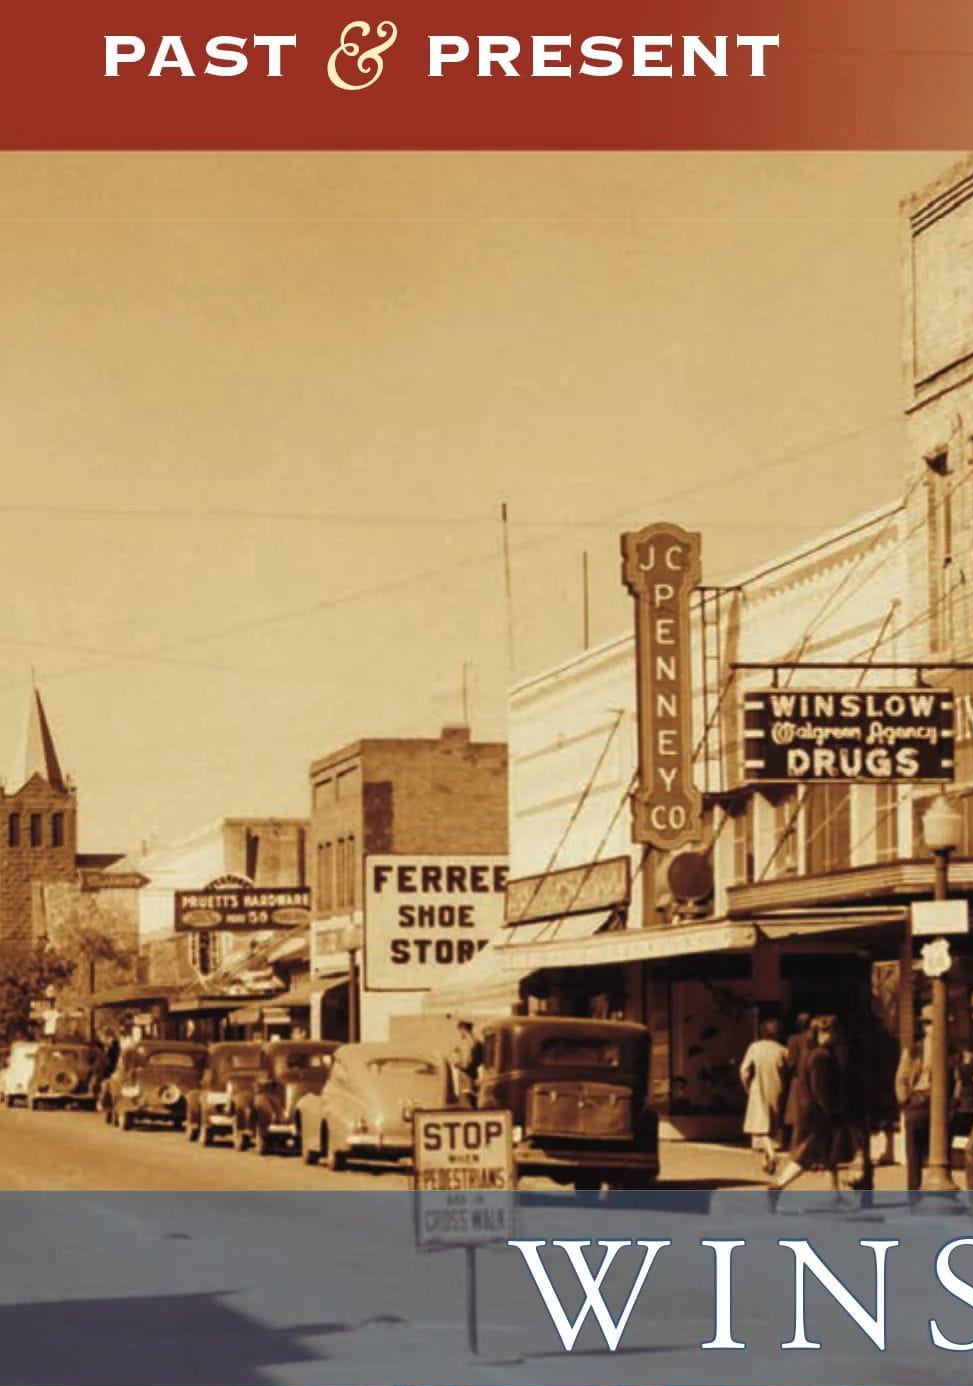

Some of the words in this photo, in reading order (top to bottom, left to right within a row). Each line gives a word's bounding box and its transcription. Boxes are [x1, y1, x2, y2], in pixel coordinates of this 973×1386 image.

[653, 583, 680, 793] PENNEY
[769, 694, 936, 718] WINSLOW
[770, 721, 861, 746] Walgreen
[865, 721, 938, 746] Agency
[787, 747, 920, 777] DRUGS
[650, 804, 686, 830] CO
[373, 865, 510, 894] FERREE
[398, 904, 475, 928] SHOE
[389, 938, 489, 965] STOR
[423, 1121, 503, 1151] STOP
[422, 1167, 505, 1191] PEDESTRIANS
